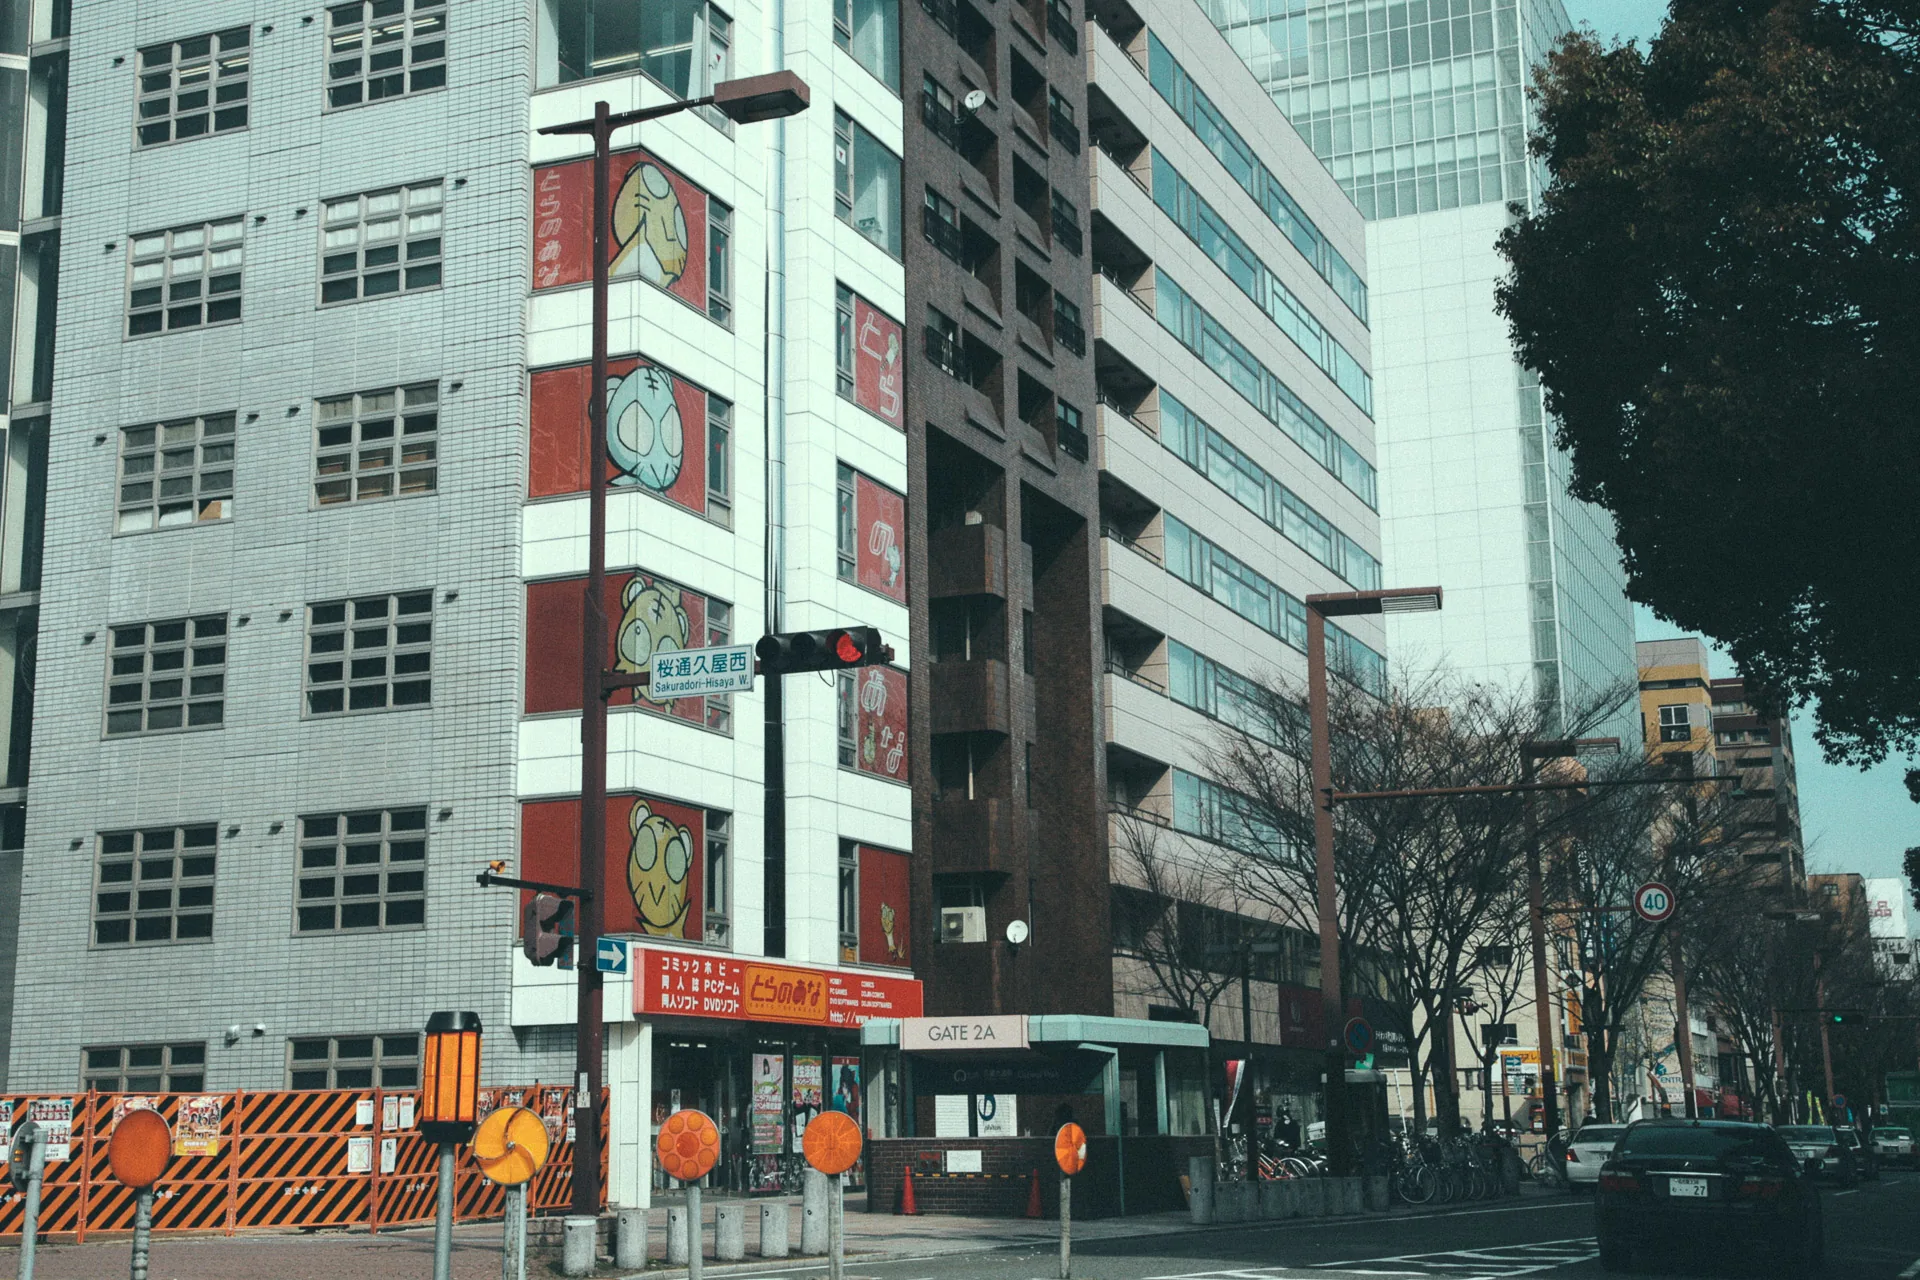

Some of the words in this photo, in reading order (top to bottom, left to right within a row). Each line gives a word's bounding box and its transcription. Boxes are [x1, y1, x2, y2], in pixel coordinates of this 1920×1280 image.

[538, 169, 562, 286] とらのあな
[657, 652, 747, 678] 桜通久屋西
[655, 678, 734, 693] Sakuradori-Hisaya
[739, 675, 749, 685] W.
[1644, 893, 1665, 910] 40
[662, 957, 700, 974] コミック
[704, 961, 740, 976] ホビー
[661, 974, 700, 993] 同人誌
[704, 979, 740, 996] PCゲーム
[751, 974, 821, 1007] とらのあな
[661, 993, 699, 1010] 同人ソフト
[704, 997, 740, 1014] DVDソフト
[928, 1025, 968, 1041] GATE
[973, 1024, 996, 1040] 2A
